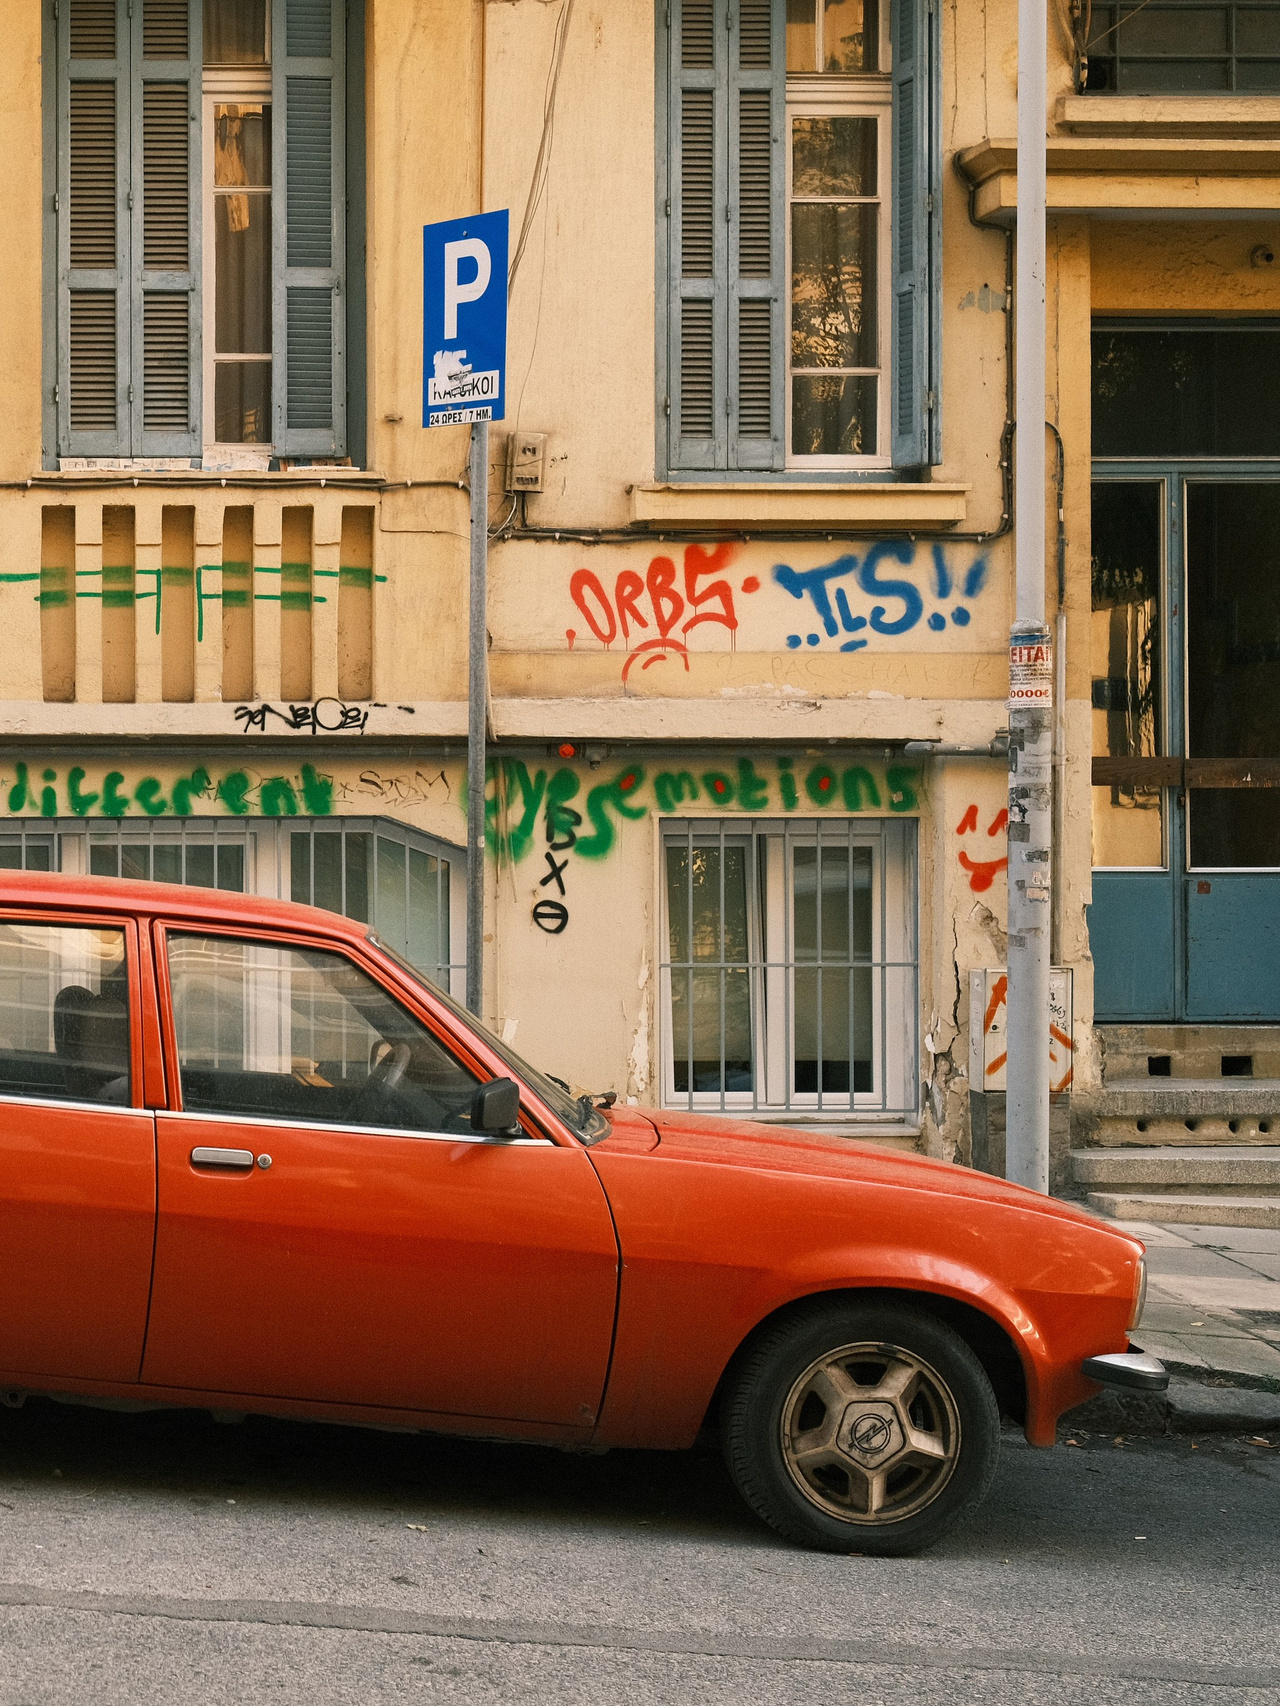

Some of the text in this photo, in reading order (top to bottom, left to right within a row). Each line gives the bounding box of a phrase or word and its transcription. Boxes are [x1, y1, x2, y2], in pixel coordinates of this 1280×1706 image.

[444, 237, 492, 341] P
[430, 414, 440, 426] 24
[441, 411, 463, 425] ΩΡΕΣ
[469, 410, 474, 422] 7
[475, 408, 491, 420] ΗΜ.
[612, 755, 921, 820] emotions
